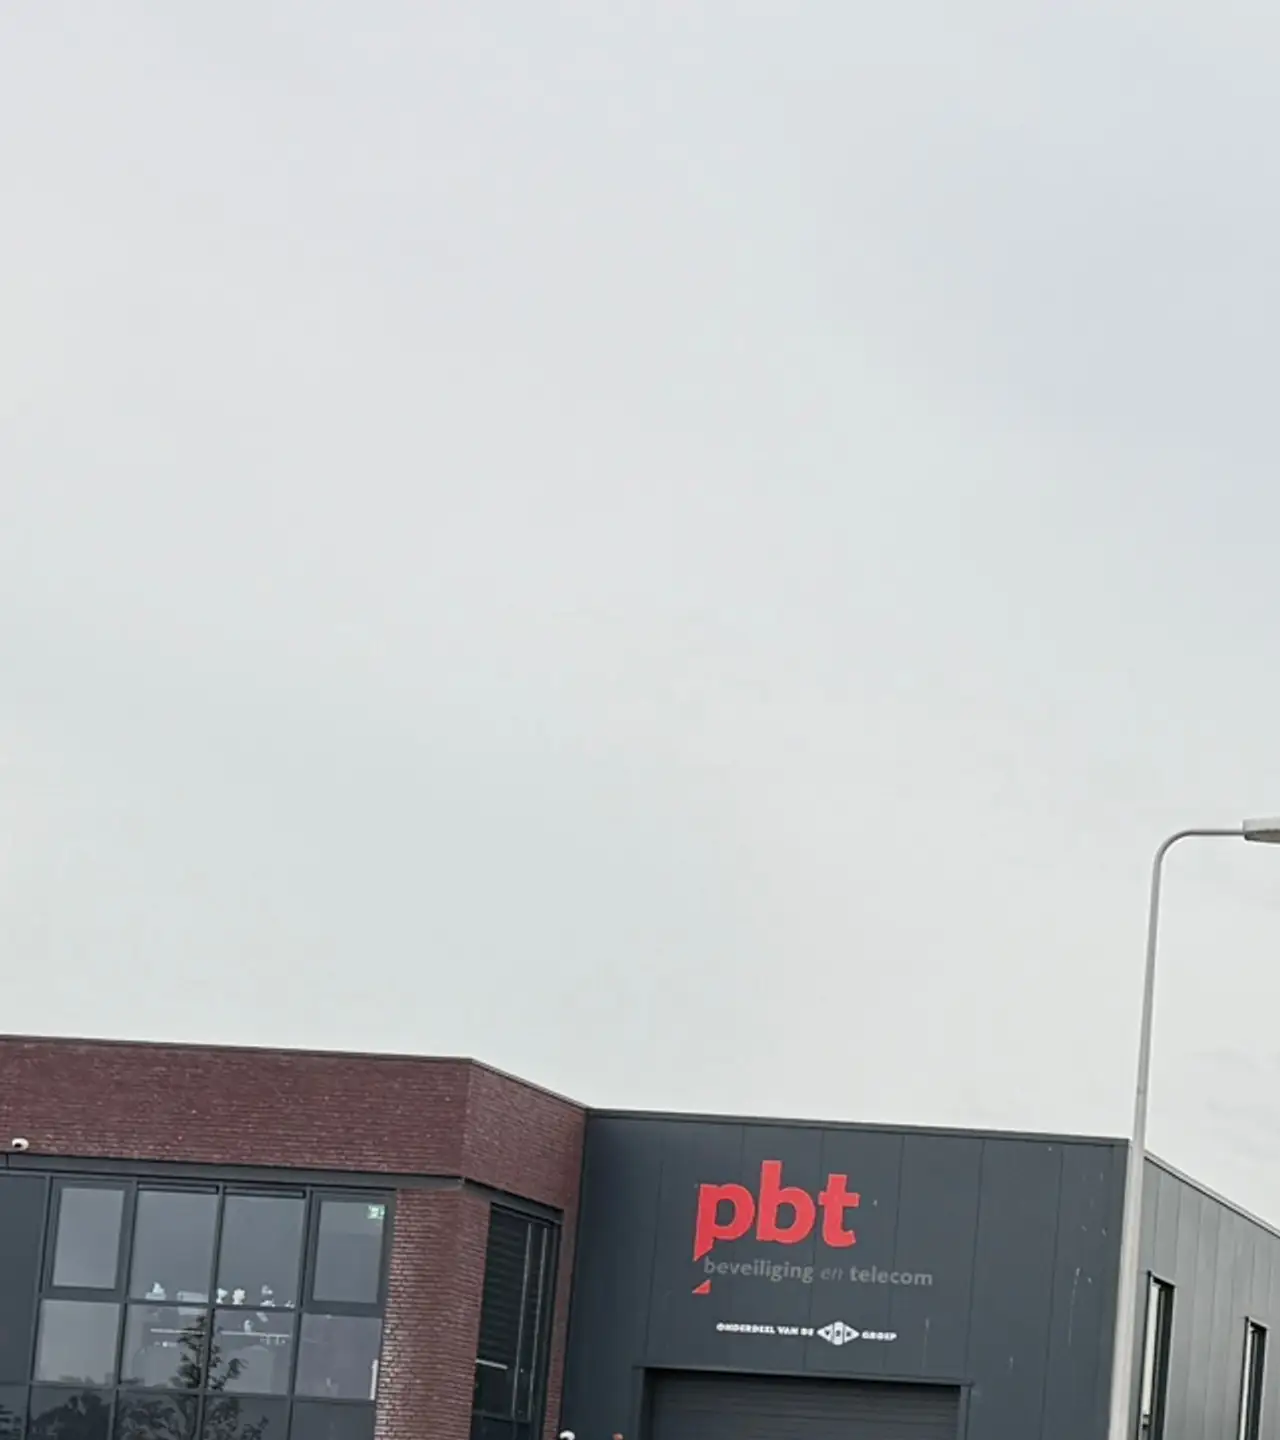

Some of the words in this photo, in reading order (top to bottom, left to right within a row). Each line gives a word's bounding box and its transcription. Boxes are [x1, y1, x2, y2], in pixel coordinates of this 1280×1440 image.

[692, 1160, 860, 1293] pbt
[704, 1256, 815, 1284] beveiliging
[820, 1269, 845, 1283] en
[849, 1264, 934, 1286] telecom
[776, 1326, 799, 1336] VAN
